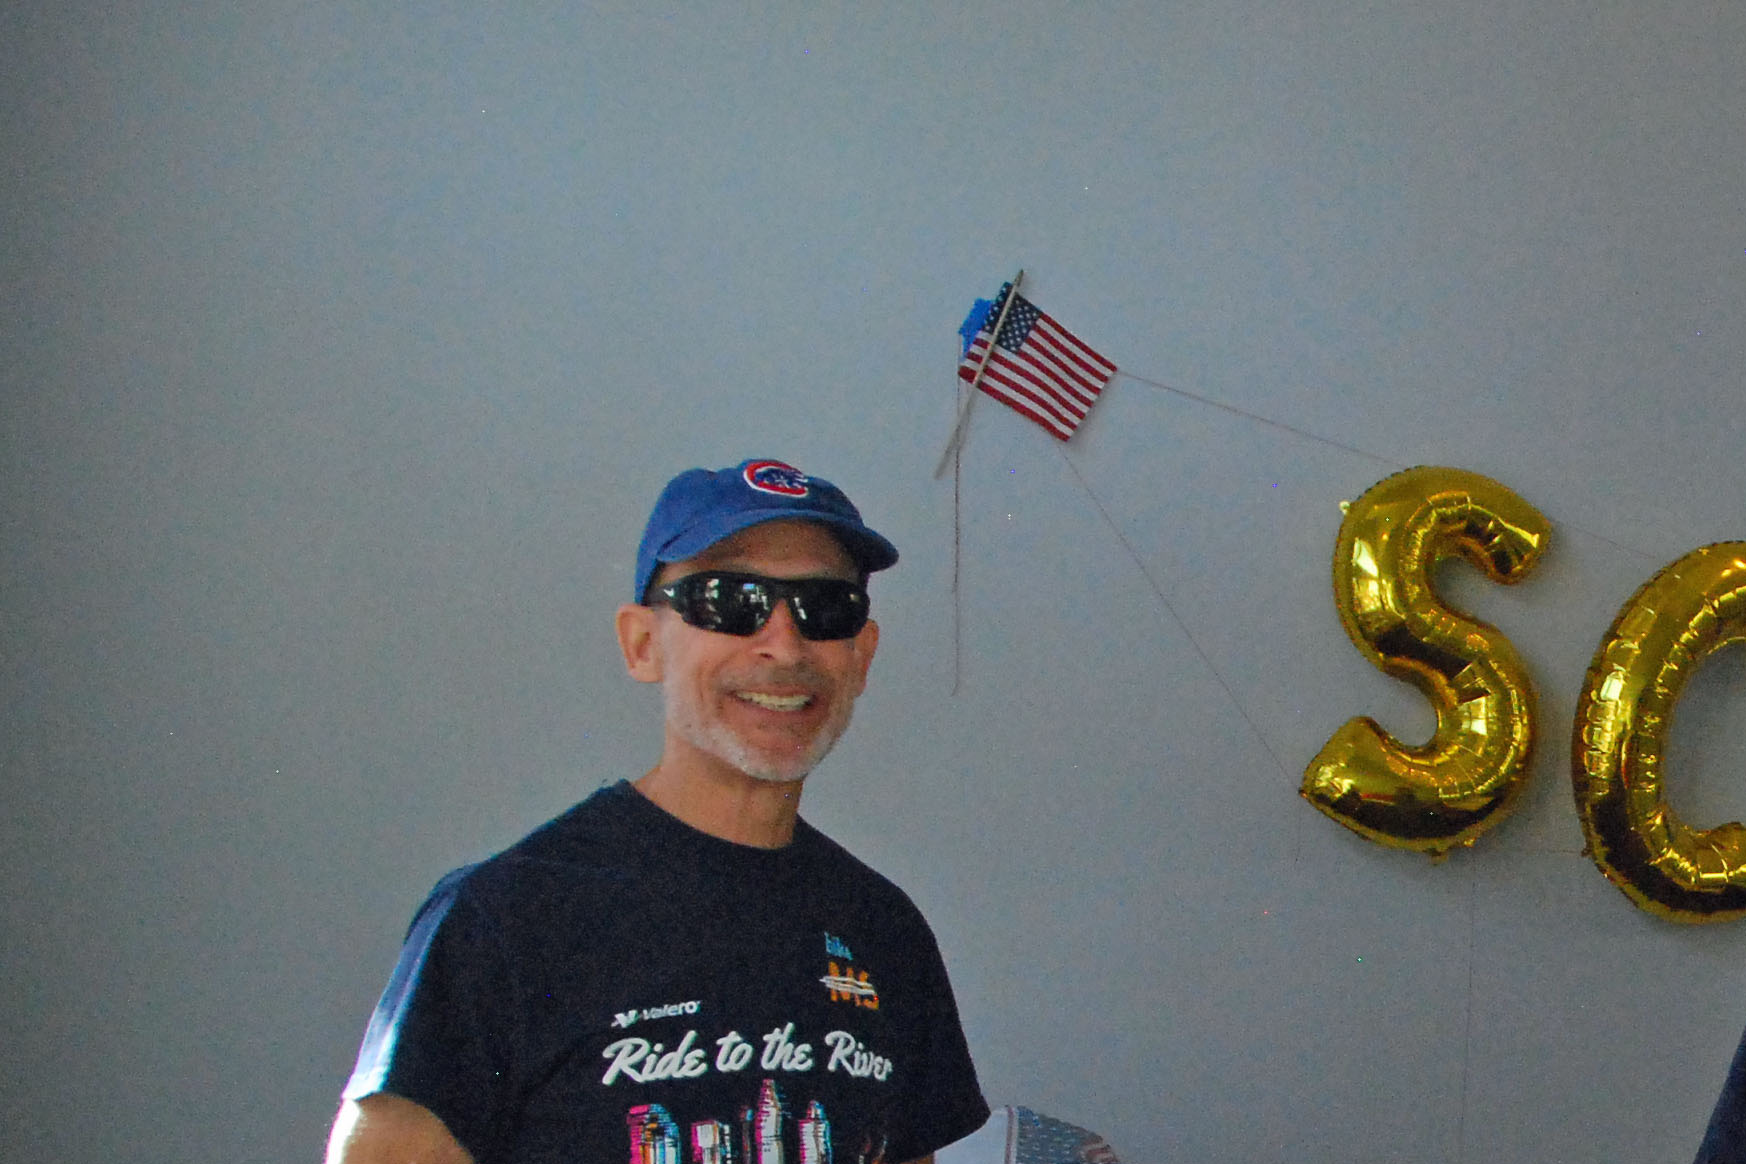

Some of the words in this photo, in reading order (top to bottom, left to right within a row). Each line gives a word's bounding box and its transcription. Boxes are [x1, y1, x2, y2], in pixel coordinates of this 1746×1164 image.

[602, 1030, 708, 1085] Ride
[715, 1031, 754, 1072] to
[760, 1021, 813, 1071] the
[824, 1030, 893, 1082] River
